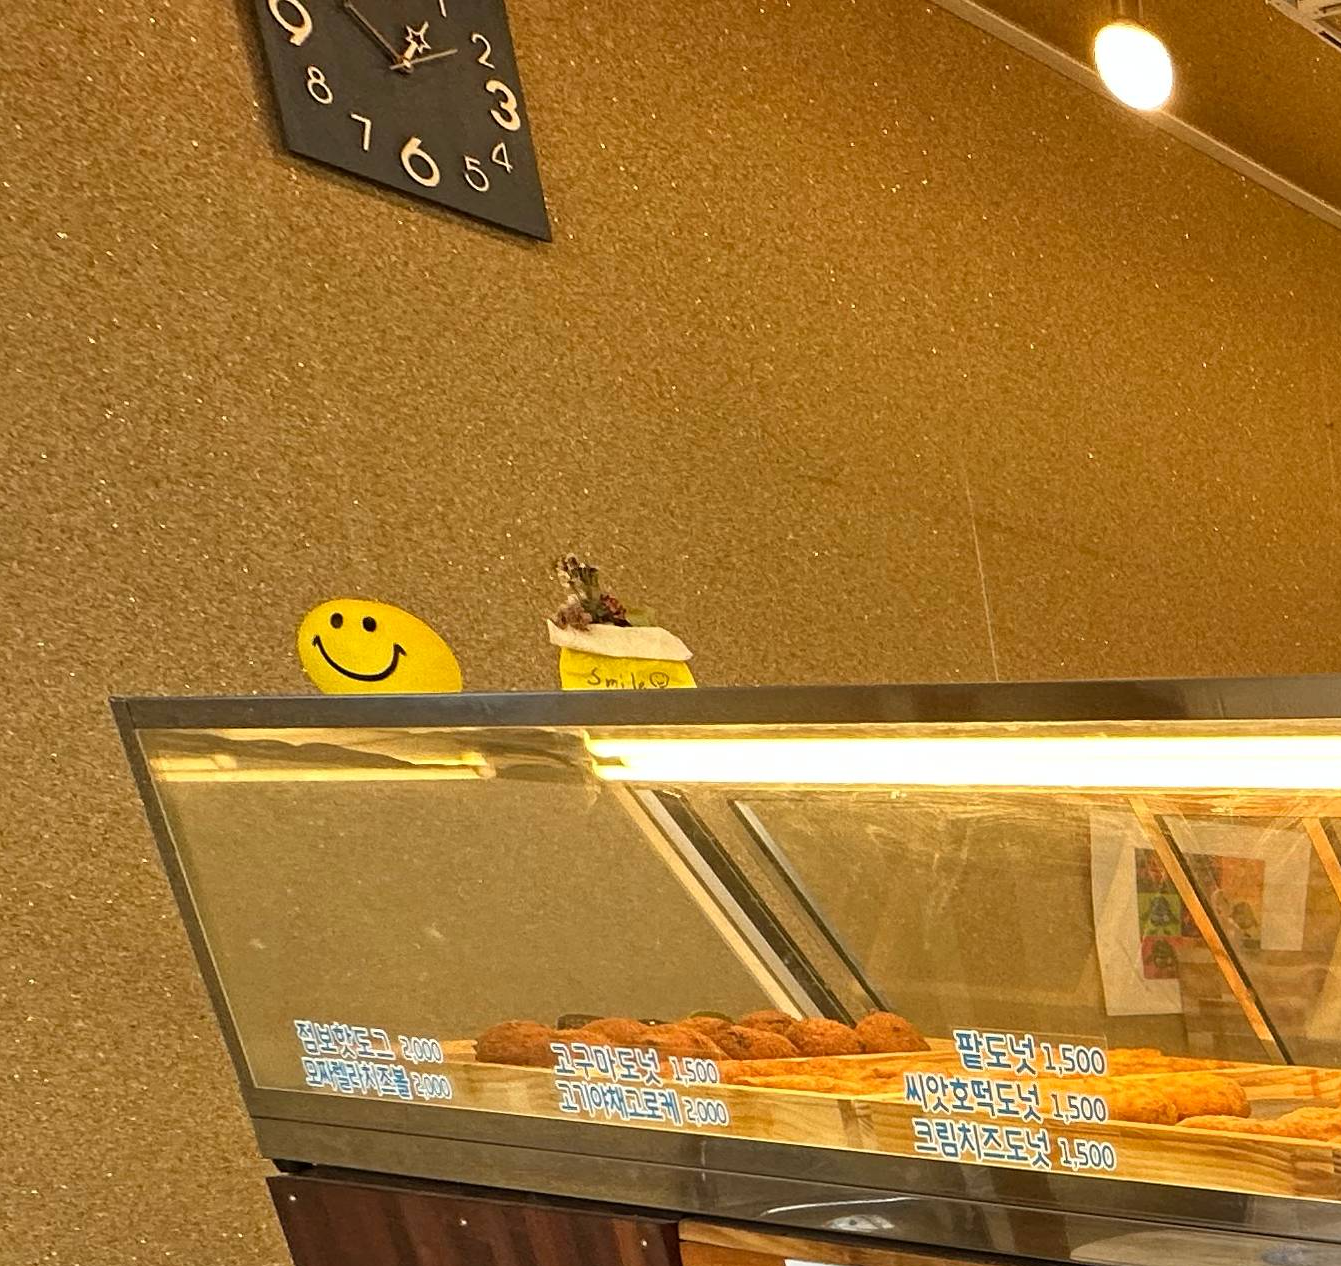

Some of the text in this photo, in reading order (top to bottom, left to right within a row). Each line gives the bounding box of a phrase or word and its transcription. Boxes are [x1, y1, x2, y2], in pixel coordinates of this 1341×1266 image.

[269, 0, 313, 46] 9
[471, 33, 496, 69] 2
[307, 65, 333, 104] 8
[486, 80, 521, 131] 3
[351, 113, 371, 151] 7
[401, 137, 440, 187] 6
[464, 155, 490, 192] 5
[491, 142, 513, 173] 4
[296, 1021, 443, 1064] 점보핫도그 2,000
[955, 1031, 1107, 1076] 팥도넛 1,500
[413, 1074, 452, 1100] 2,000
[551, 1043, 720, 1087] 고구마도넛 1,500
[557, 1080, 730, 1126] 고기야채고로케 2,000
[904, 1073, 1108, 1124] 씨앗호떡도넛 1,500
[914, 1120, 1116, 1171] 크림치즈도넛 1,500
